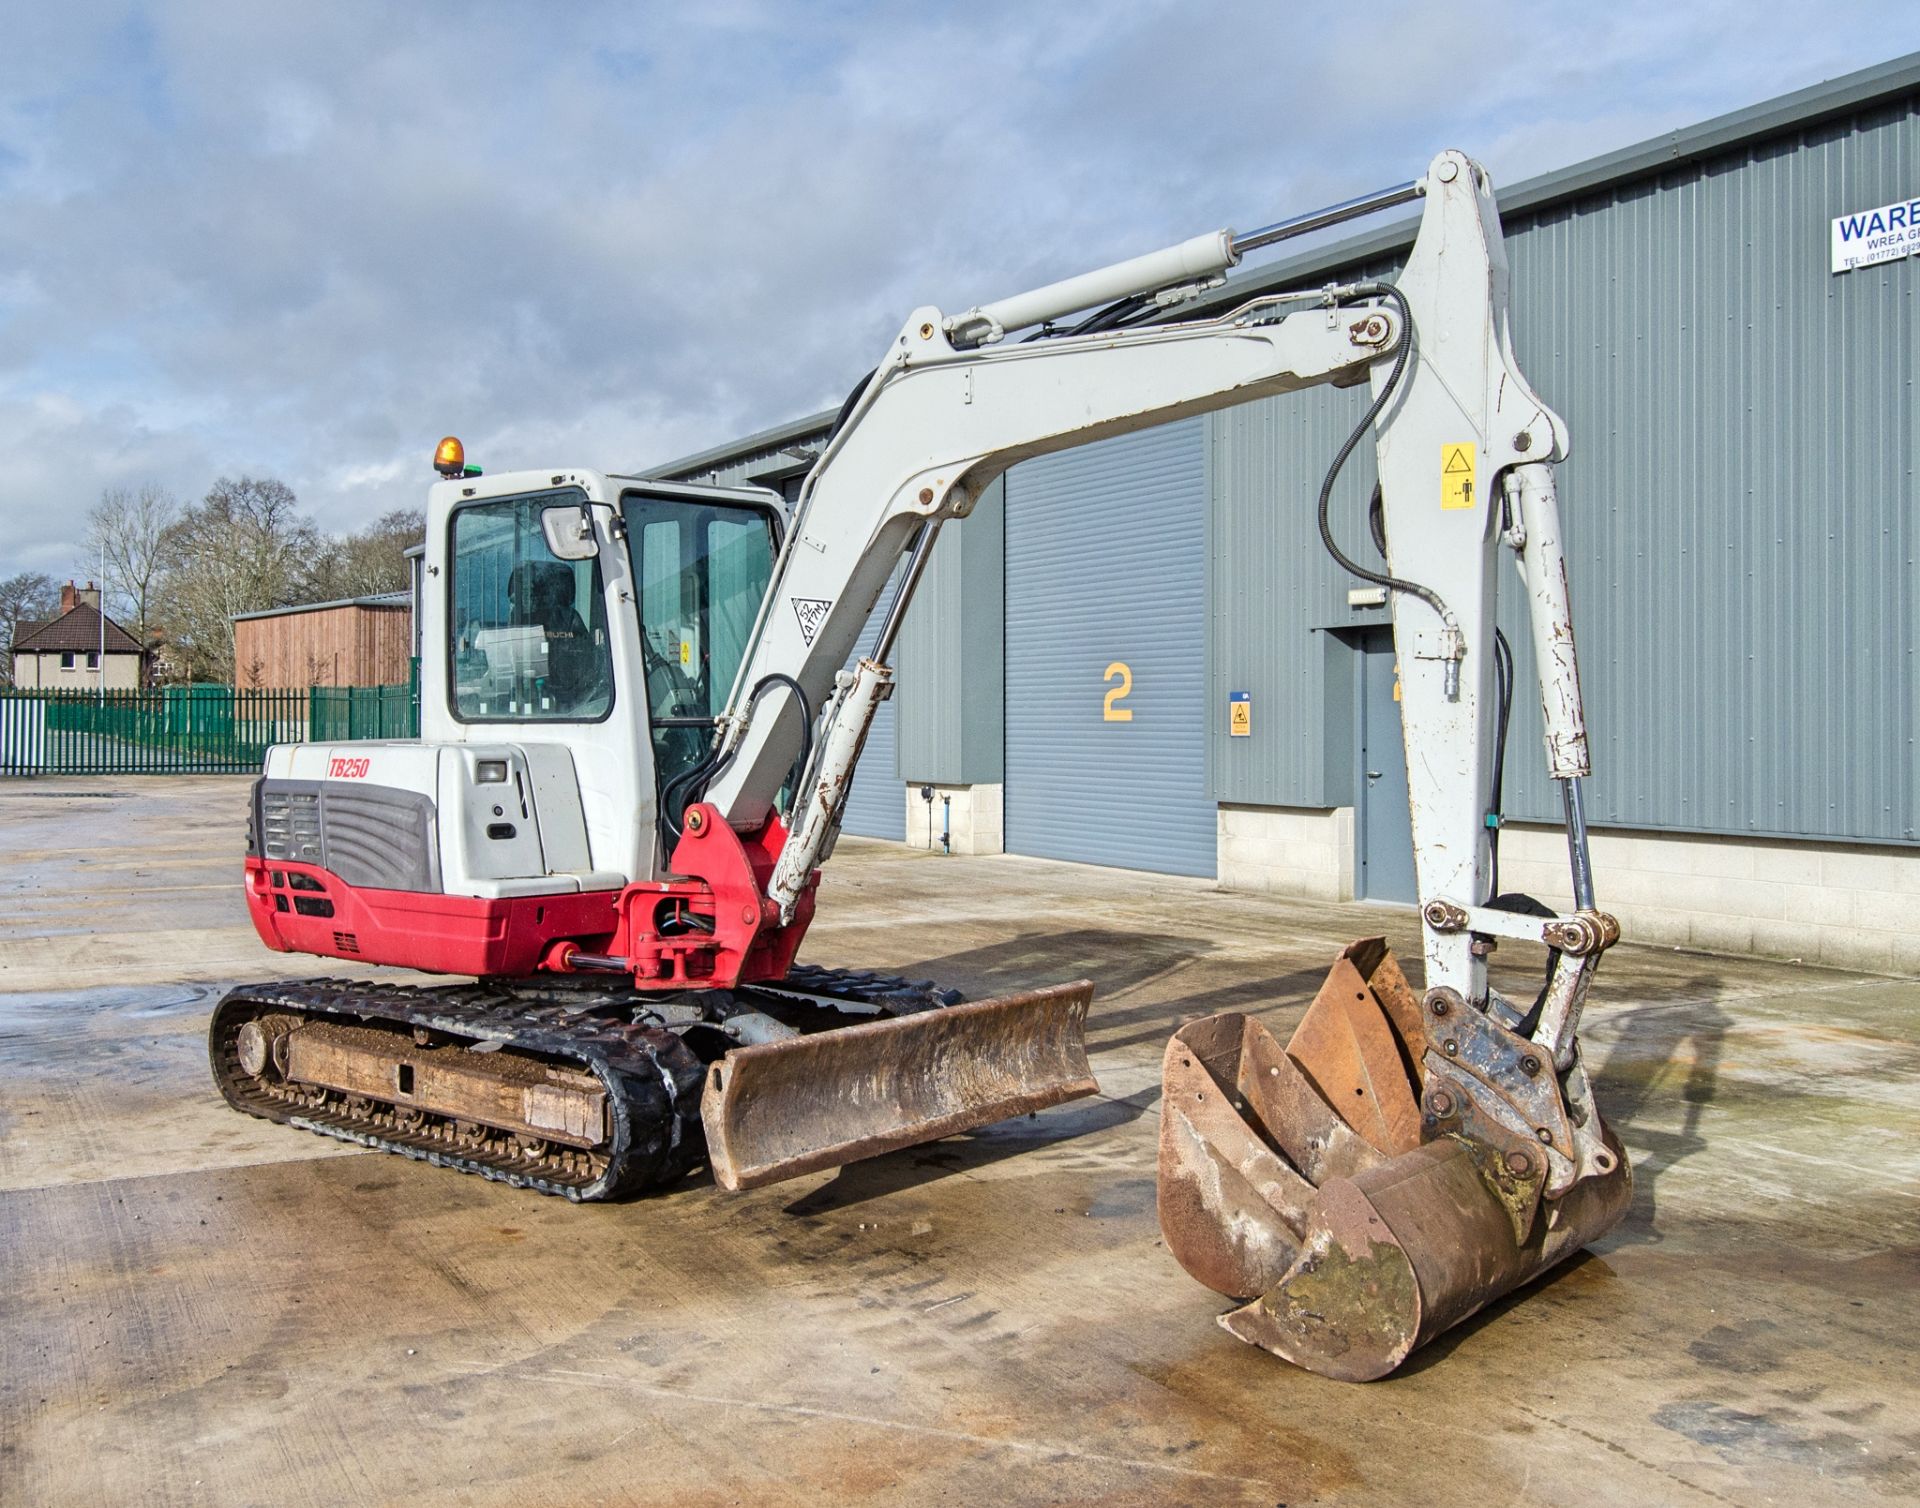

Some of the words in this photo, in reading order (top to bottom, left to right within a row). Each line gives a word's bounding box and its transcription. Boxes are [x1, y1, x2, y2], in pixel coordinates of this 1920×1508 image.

[1840, 201, 1920, 242] WARE
[1867, 233, 1904, 250] WREA
[1867, 247, 1899, 263] (01772)
[800, 603, 813, 620] 52
[804, 603, 824, 634] AT7M
[1104, 662, 1132, 721] 2
[329, 758, 370, 778] TB250
